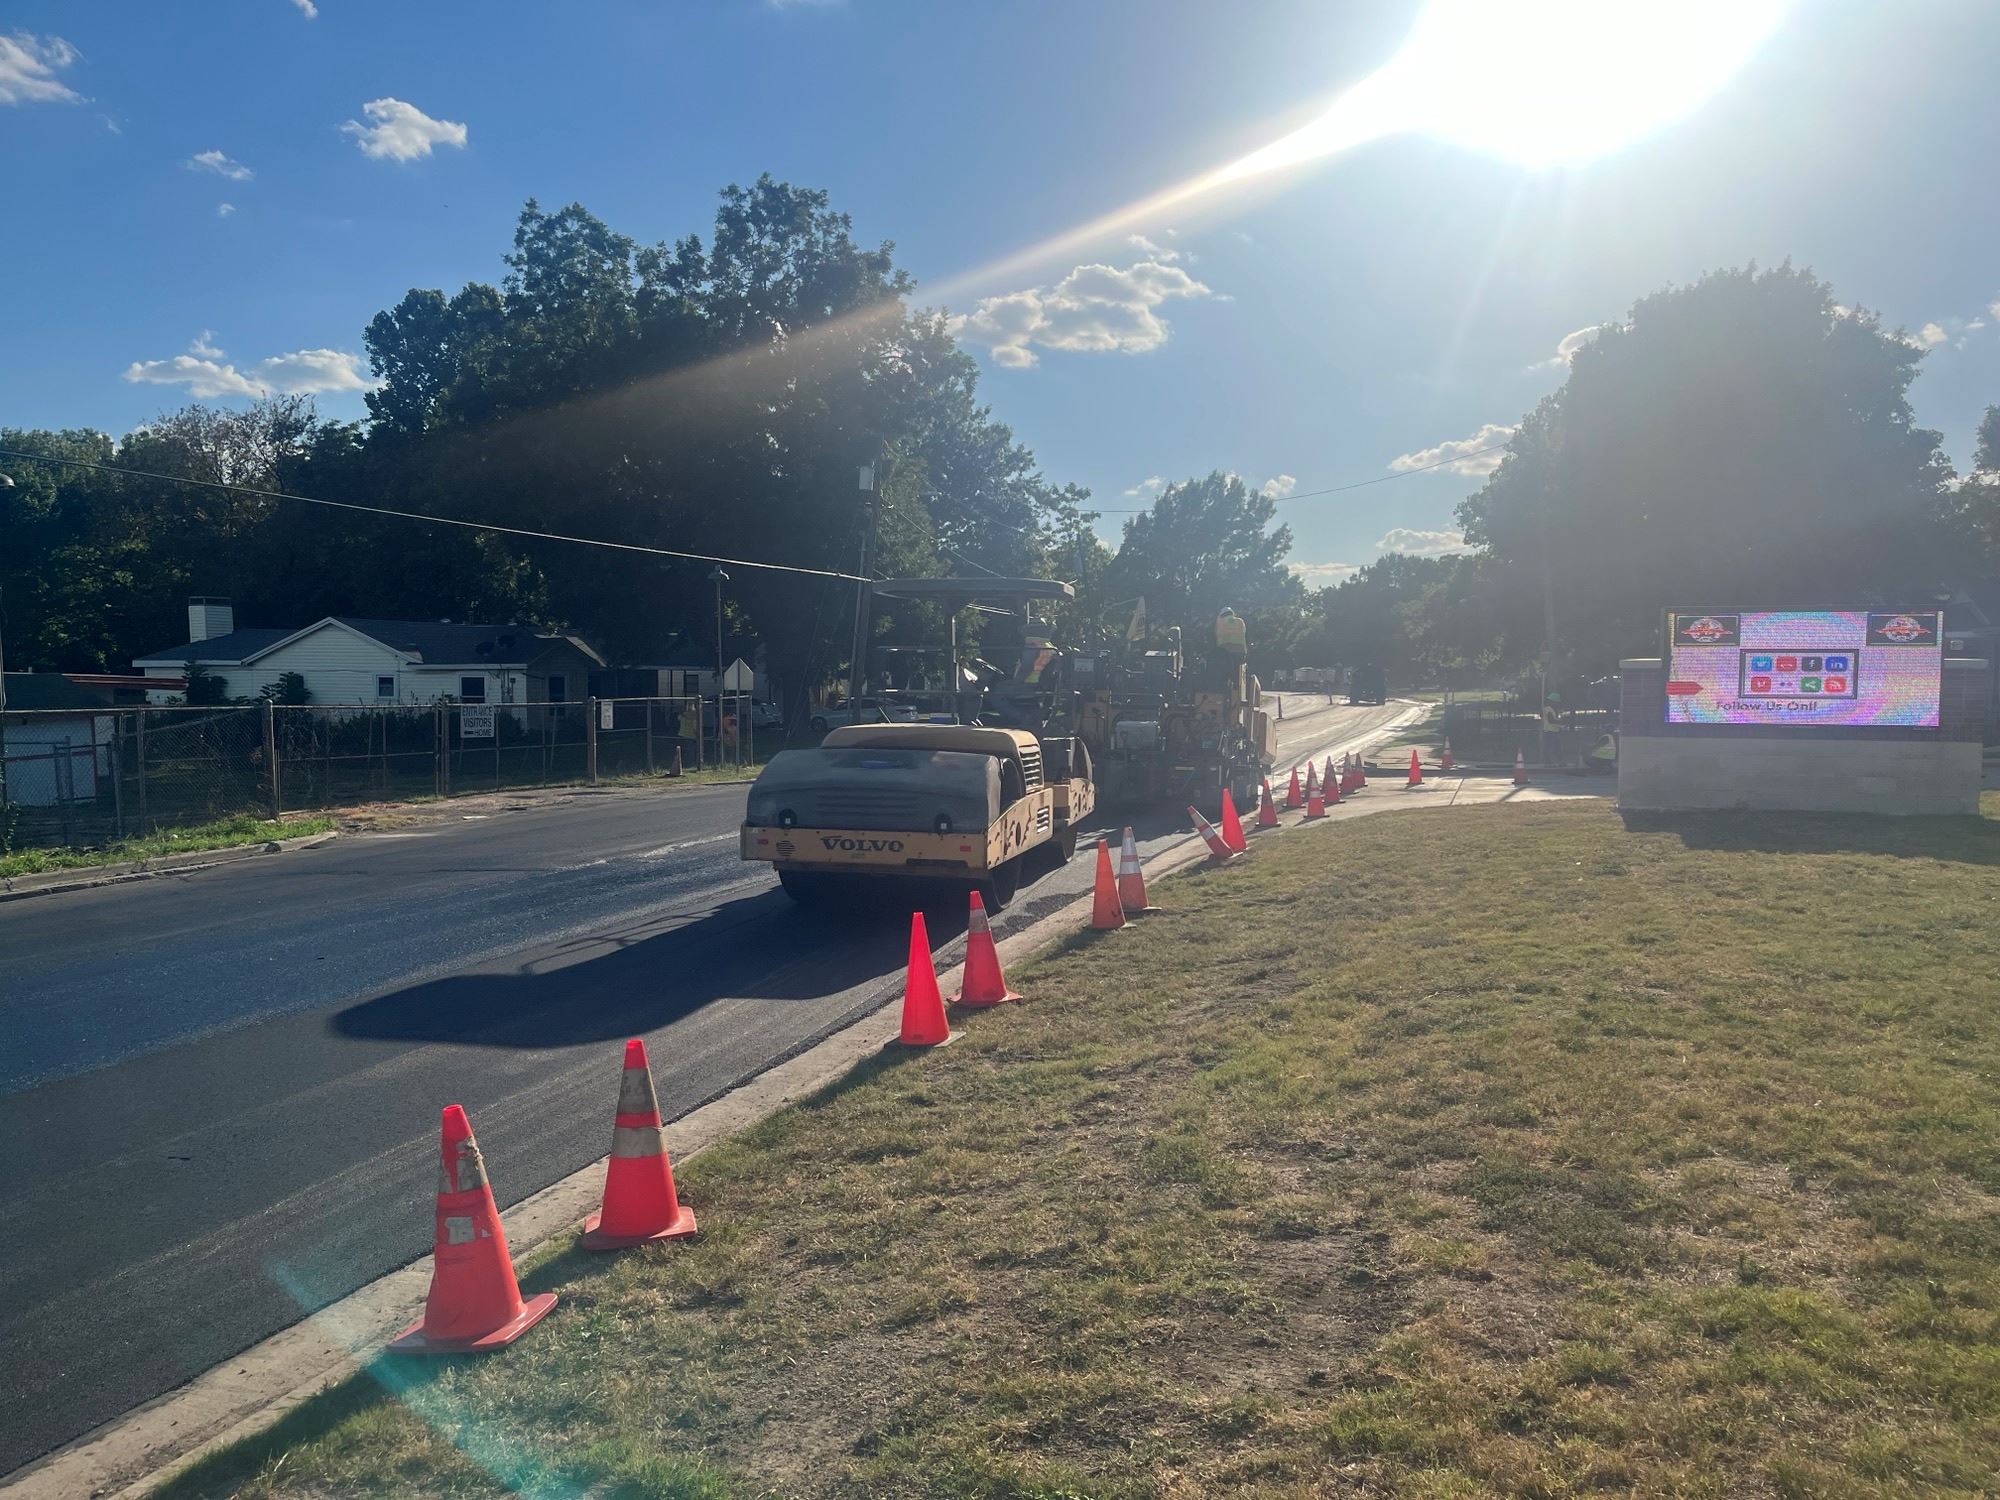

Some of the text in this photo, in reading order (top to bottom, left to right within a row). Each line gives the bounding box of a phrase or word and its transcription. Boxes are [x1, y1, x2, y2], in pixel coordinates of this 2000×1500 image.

[463, 706, 493, 716] ENTRANCE
[1716, 701, 1761, 711] Follow
[1766, 701, 1781, 711] Us
[463, 718, 492, 728] VISITORS
[475, 729, 492, 737] HOME
[820, 837, 904, 852] VOLVO
